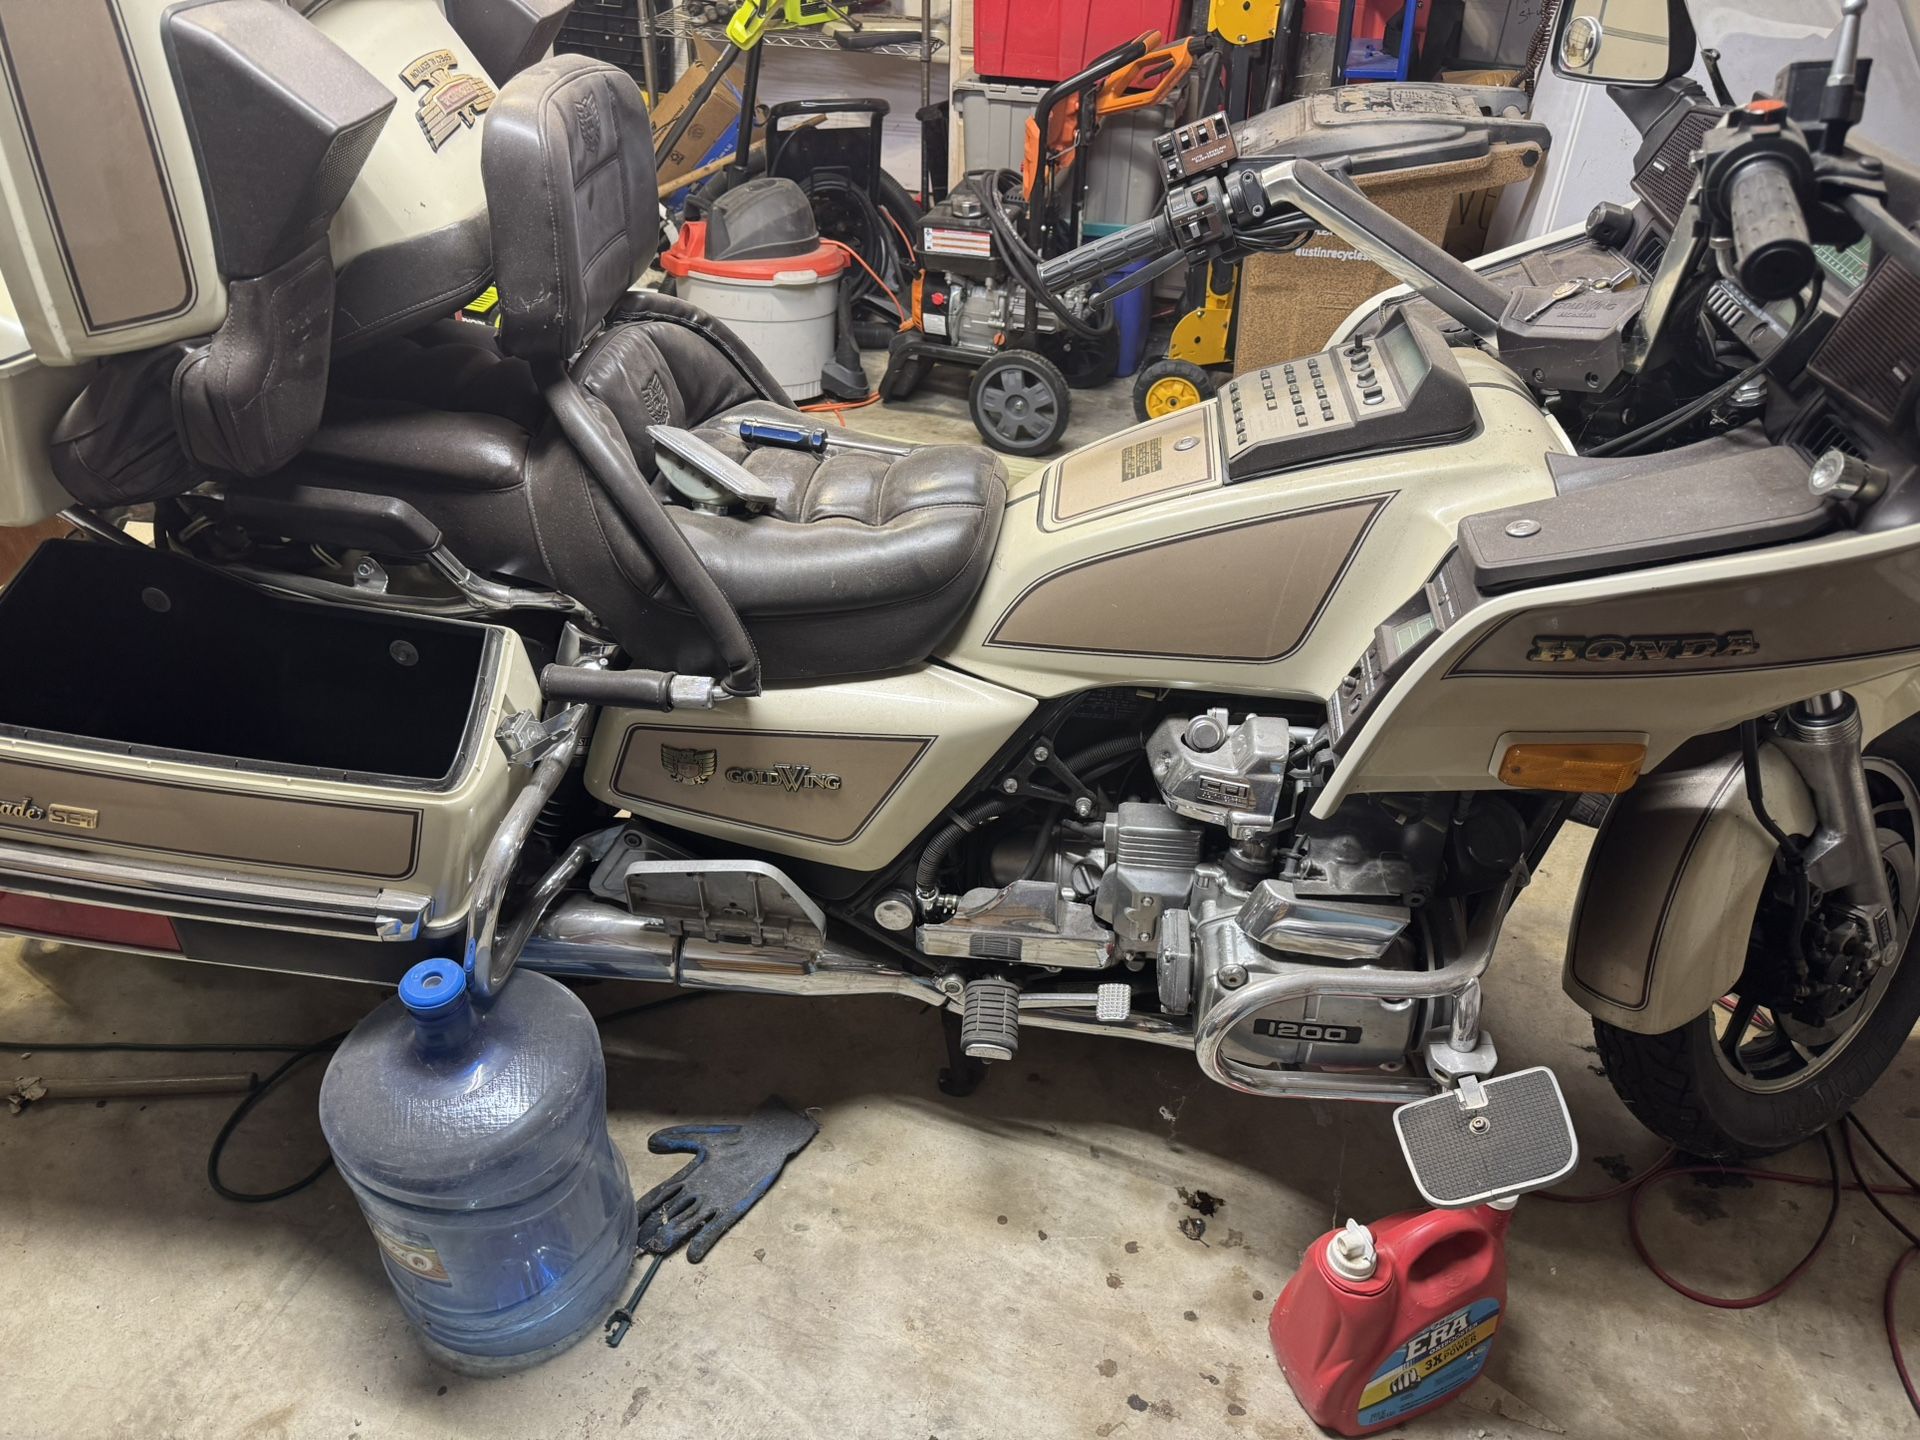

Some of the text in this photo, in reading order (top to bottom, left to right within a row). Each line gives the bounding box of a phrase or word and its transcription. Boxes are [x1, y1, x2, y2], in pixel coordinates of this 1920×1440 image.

[1526, 631, 1760, 662] HONDA
[1267, 1021, 1348, 1041] 1200
[1404, 1311, 1472, 1363] ERA
[1424, 1351, 1444, 1371] 3X
[1443, 1334, 1478, 1361] POWER
